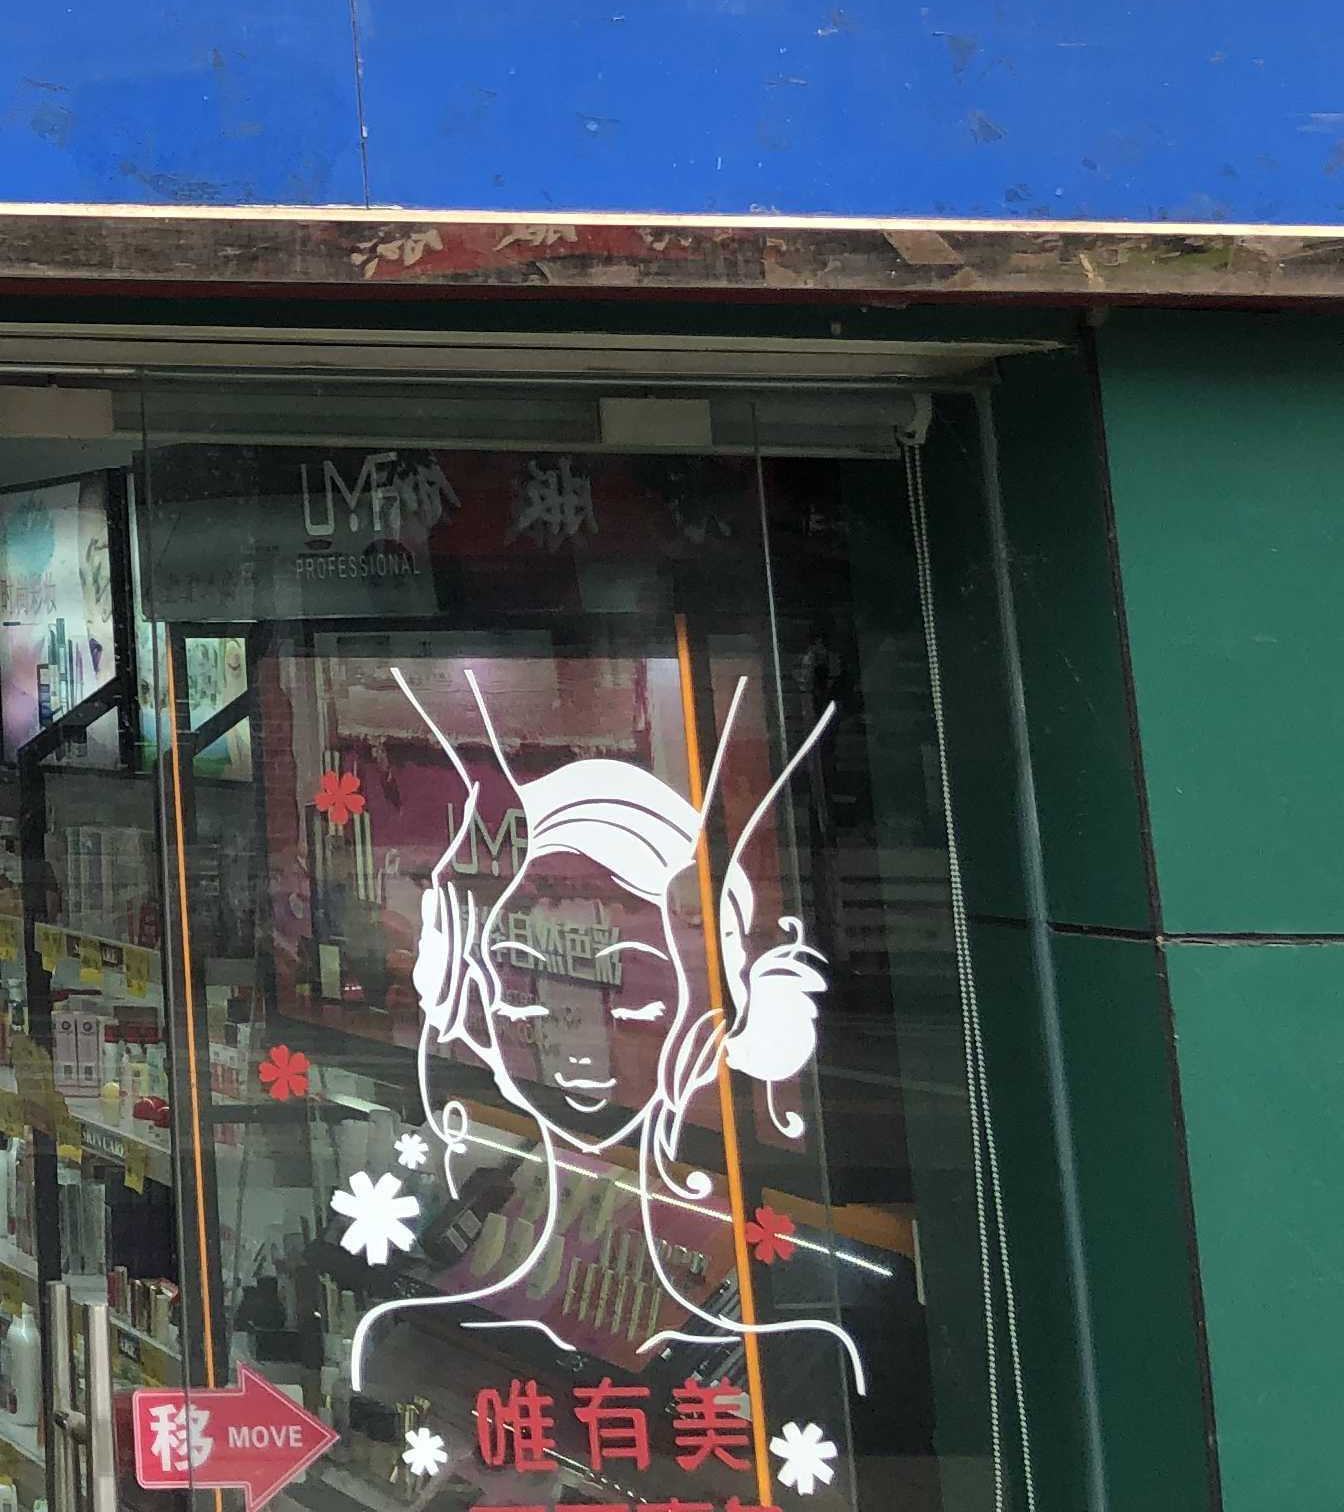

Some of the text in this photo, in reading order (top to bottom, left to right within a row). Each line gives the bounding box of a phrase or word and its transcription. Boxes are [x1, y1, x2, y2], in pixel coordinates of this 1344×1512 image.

[296, 552, 421, 579] PROFESSIONAL
[149, 1403, 303, 1472] 移 MOVE
[476, 1377, 752, 1473] 唯有美
